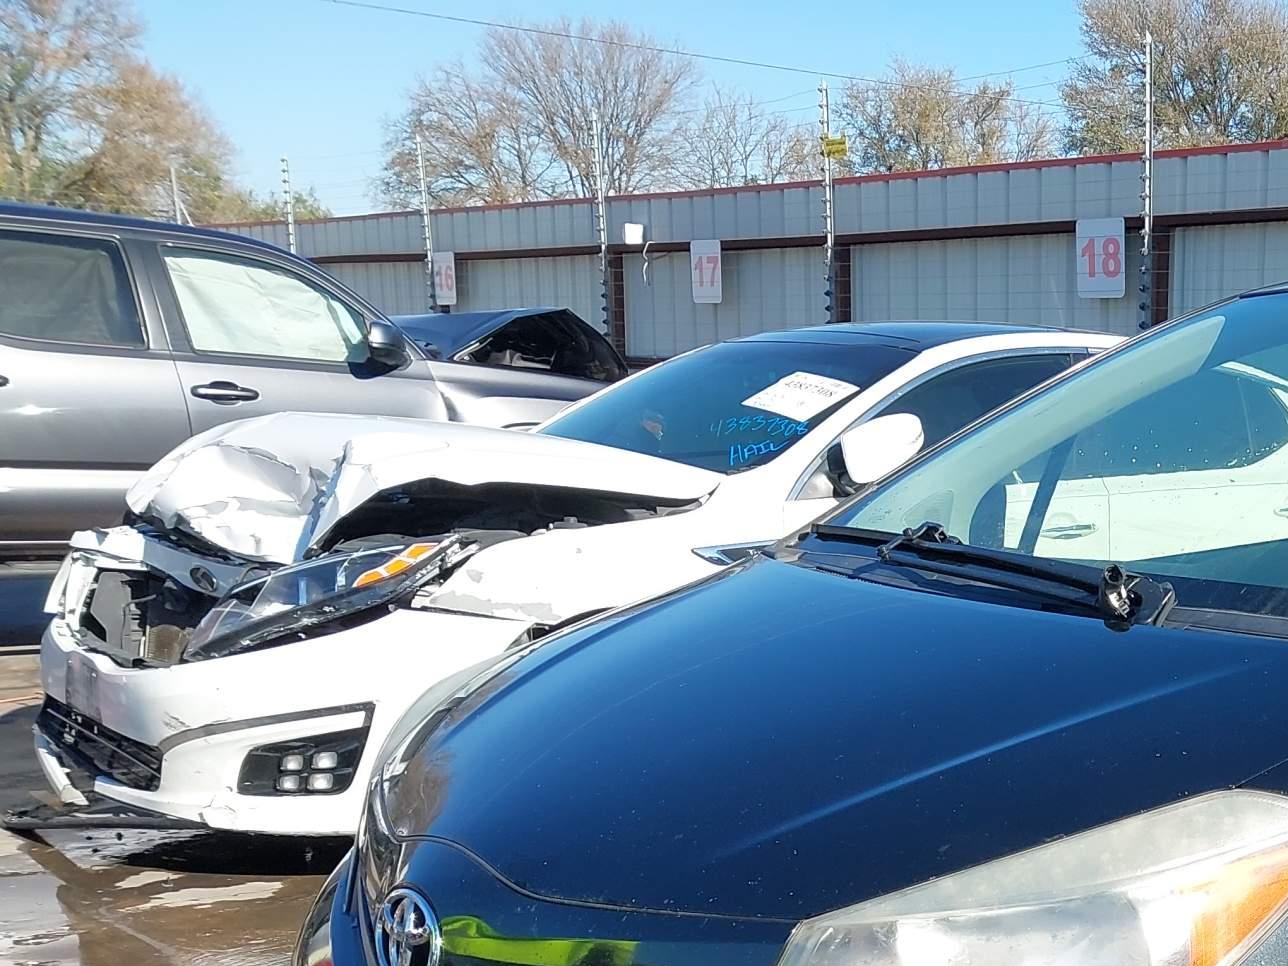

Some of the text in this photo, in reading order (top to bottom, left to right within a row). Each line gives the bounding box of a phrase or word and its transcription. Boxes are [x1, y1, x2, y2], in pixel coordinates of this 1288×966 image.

[1080, 237, 1122, 279] 18
[435, 265, 454, 291] 16
[694, 255, 719, 288] 17
[709, 416, 809, 438] 43837308
[729, 440, 790, 466] HAIL
